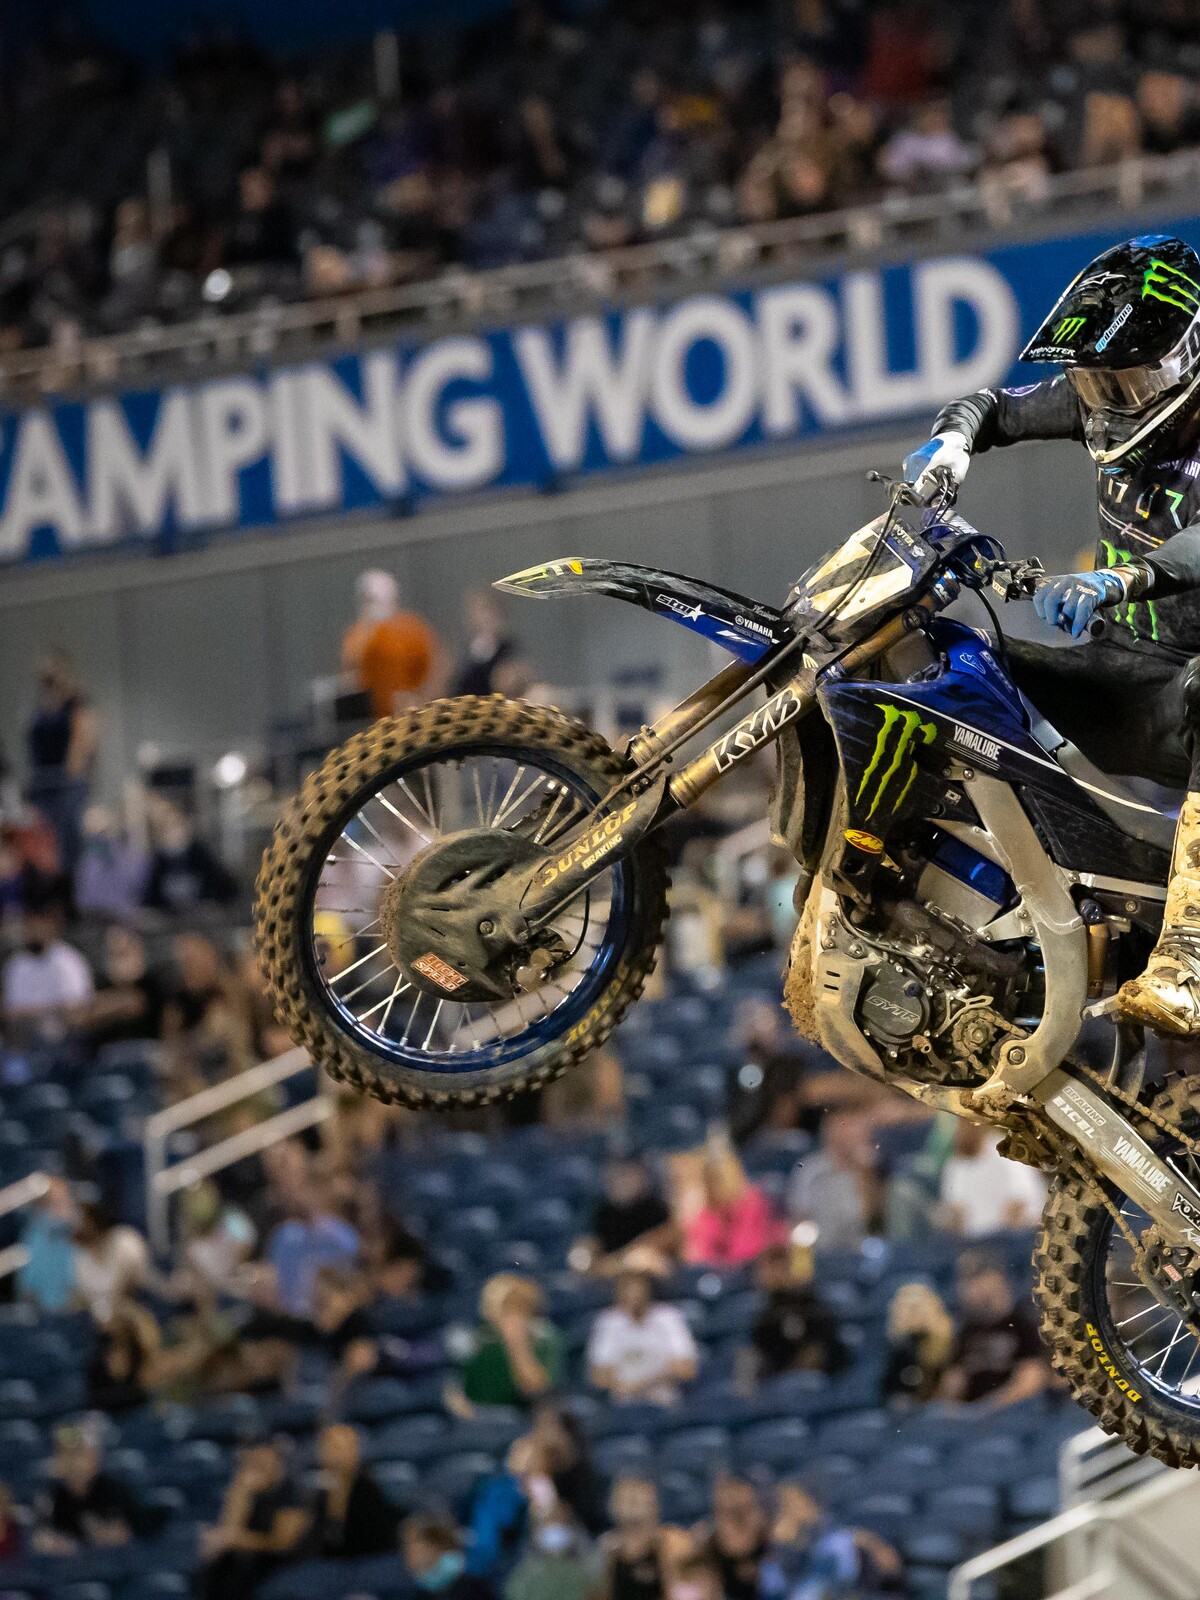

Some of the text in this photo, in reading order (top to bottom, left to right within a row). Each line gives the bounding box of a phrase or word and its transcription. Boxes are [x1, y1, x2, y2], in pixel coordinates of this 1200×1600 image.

[0, 257, 1018, 558] AMPING WORLD
[744, 618, 773, 639] YAMAHA
[711, 686, 802, 774] KYB
[953, 725, 1002, 761] YAMALUBE
[582, 834, 623, 869] BRAKING
[416, 961, 456, 990] SPEED
[1063, 1088, 1105, 1126] BRAKING
[1112, 1136, 1173, 1193] YAMALUBE
[1085, 1323, 1143, 1402] DUNLOP
